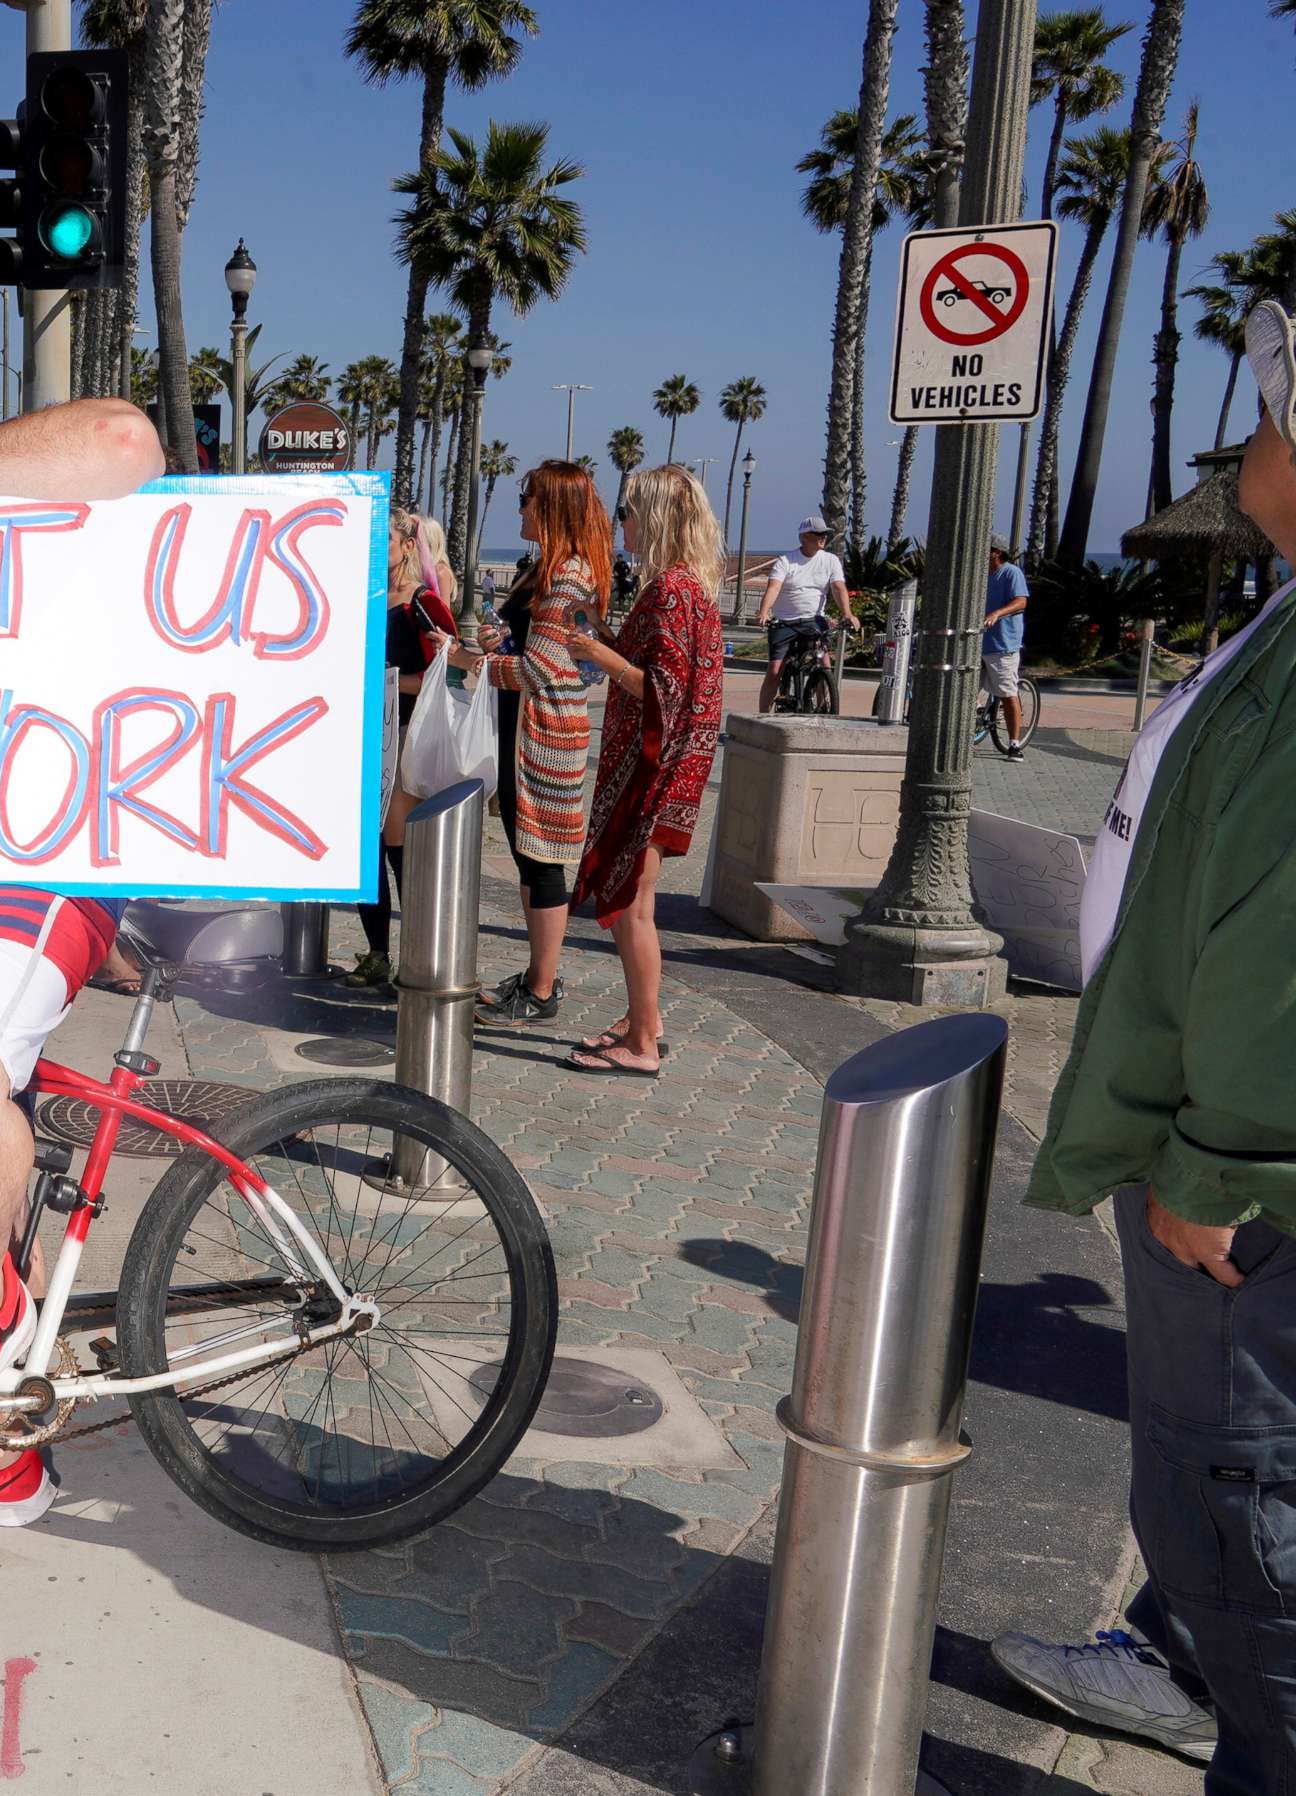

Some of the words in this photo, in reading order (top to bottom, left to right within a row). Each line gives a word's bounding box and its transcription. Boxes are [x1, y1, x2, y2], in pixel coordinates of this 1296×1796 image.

[951, 354, 984, 377] NO
[911, 383, 1022, 409] VEHICLES
[268, 427, 347, 449] DUKE'S
[276, 462, 335, 470] HUNTINGTON
[145, 499, 349, 661] US
